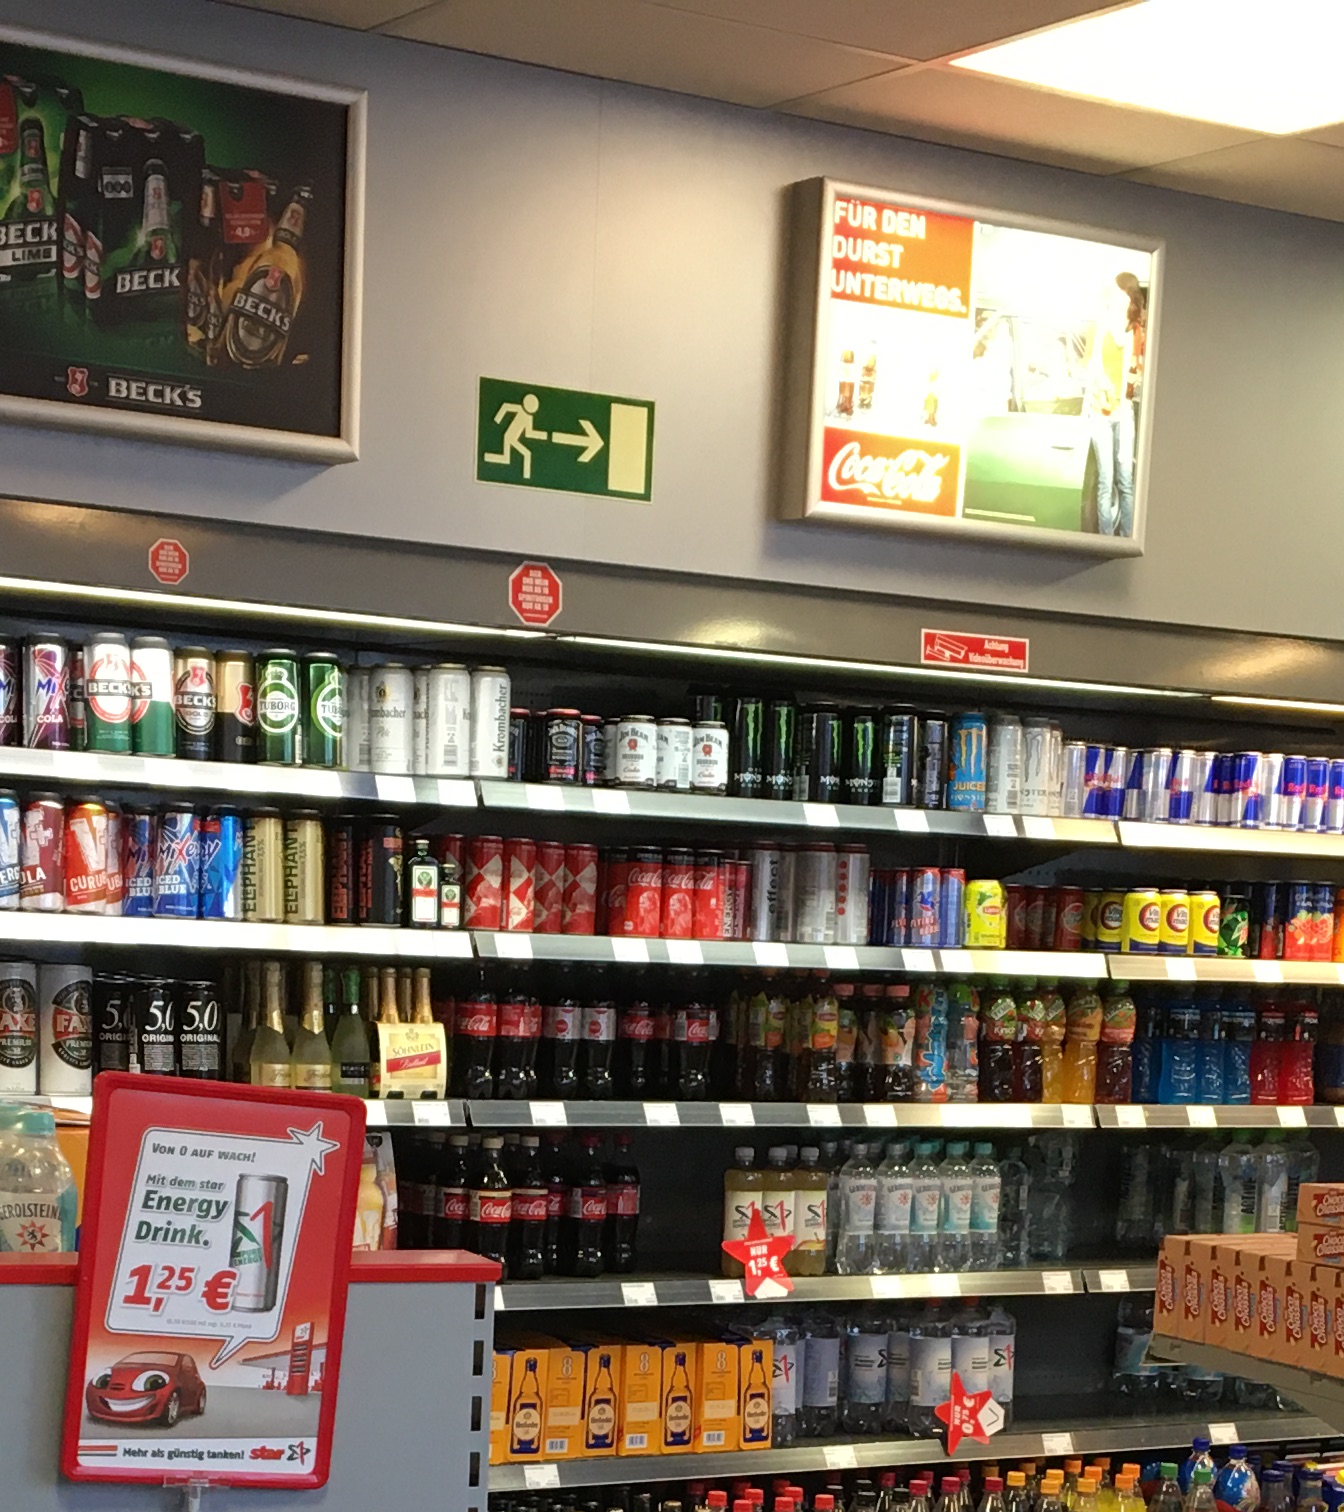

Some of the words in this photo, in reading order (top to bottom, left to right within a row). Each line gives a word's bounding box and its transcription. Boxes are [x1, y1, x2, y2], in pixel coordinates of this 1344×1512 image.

[834, 200, 877, 230] FÜR
[882, 209, 926, 240] DEN
[833, 235, 904, 269] DURST
[830, 268, 967, 314] UNTERWEGS.
[108, 377, 203, 408] BECK'S
[493, 684, 508, 752] Krombacher
[285, 827, 299, 915] ELEPHANT
[190, 1148, 214, 1159] AUF
[218, 1150, 256, 1163] WACH!
[145, 1174, 166, 1186] Mit
[170, 1176, 195, 1188] dem
[199, 1180, 224, 1191] star
[141, 1190, 228, 1219] Energy
[134, 1219, 210, 1248] Drink.
[201, 1270, 237, 1313] €
[122, 1447, 146, 1459] Mehr
[150, 1447, 164, 1459] als
[168, 1448, 204, 1462] günstig
[207, 1448, 245, 1461] tanken!
[249, 1447, 285, 1460] star
